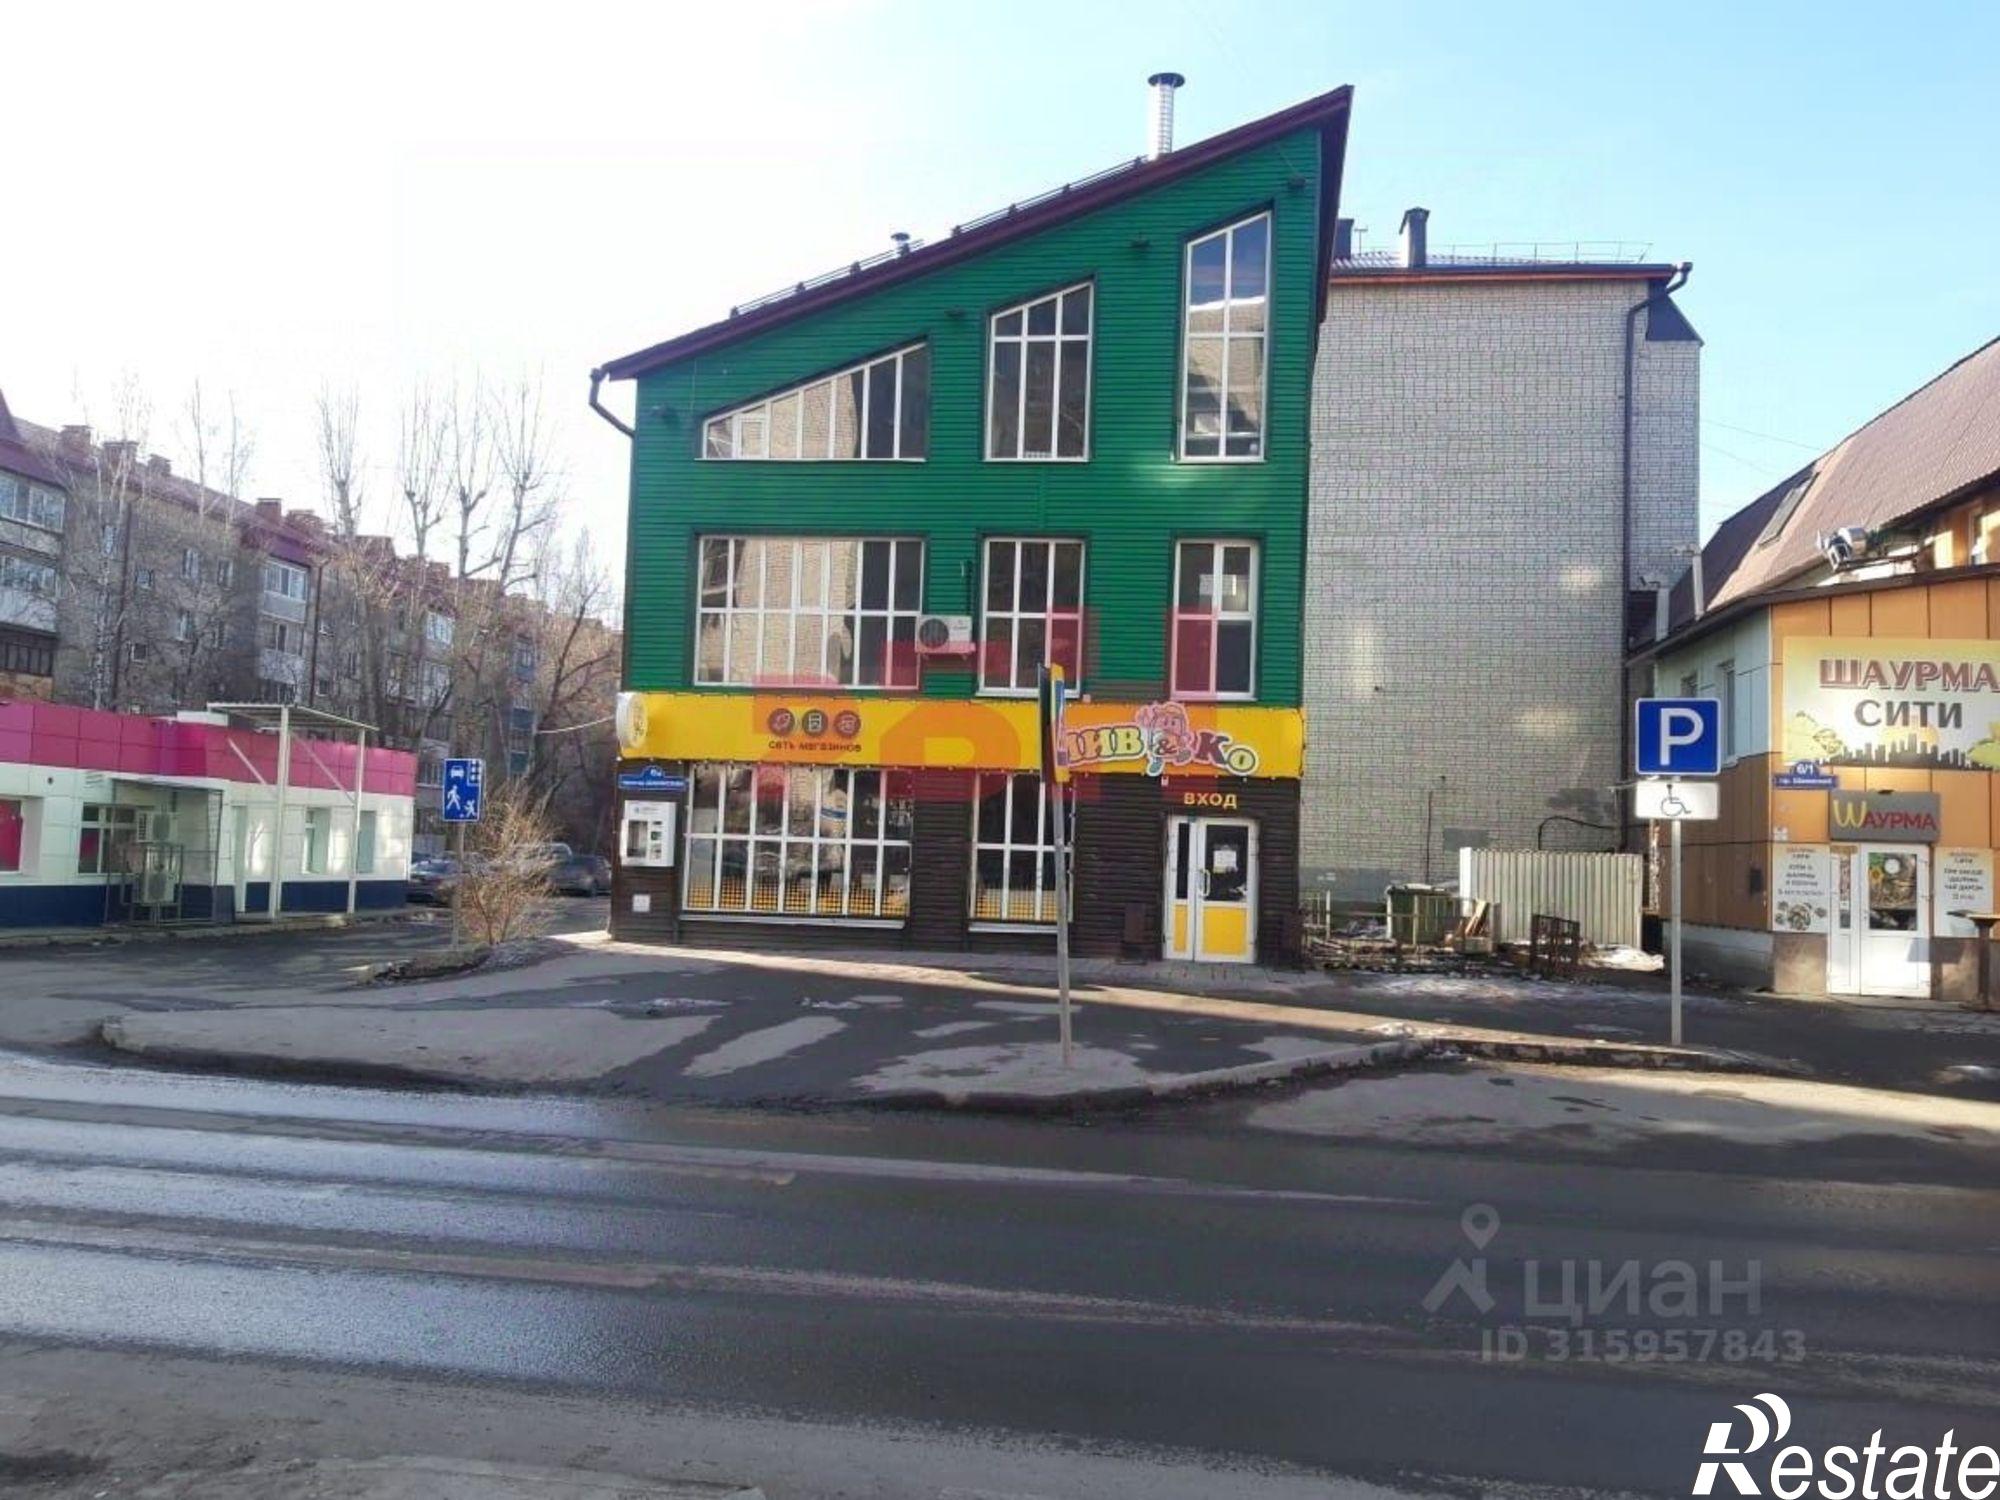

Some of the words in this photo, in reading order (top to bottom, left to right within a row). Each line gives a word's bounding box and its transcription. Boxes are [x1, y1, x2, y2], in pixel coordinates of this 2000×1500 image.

[1819, 659, 2000, 694] ШАУРМА
[1854, 699, 1963, 729] СИТИ
[1183, 792, 1237, 810] ВХОД
